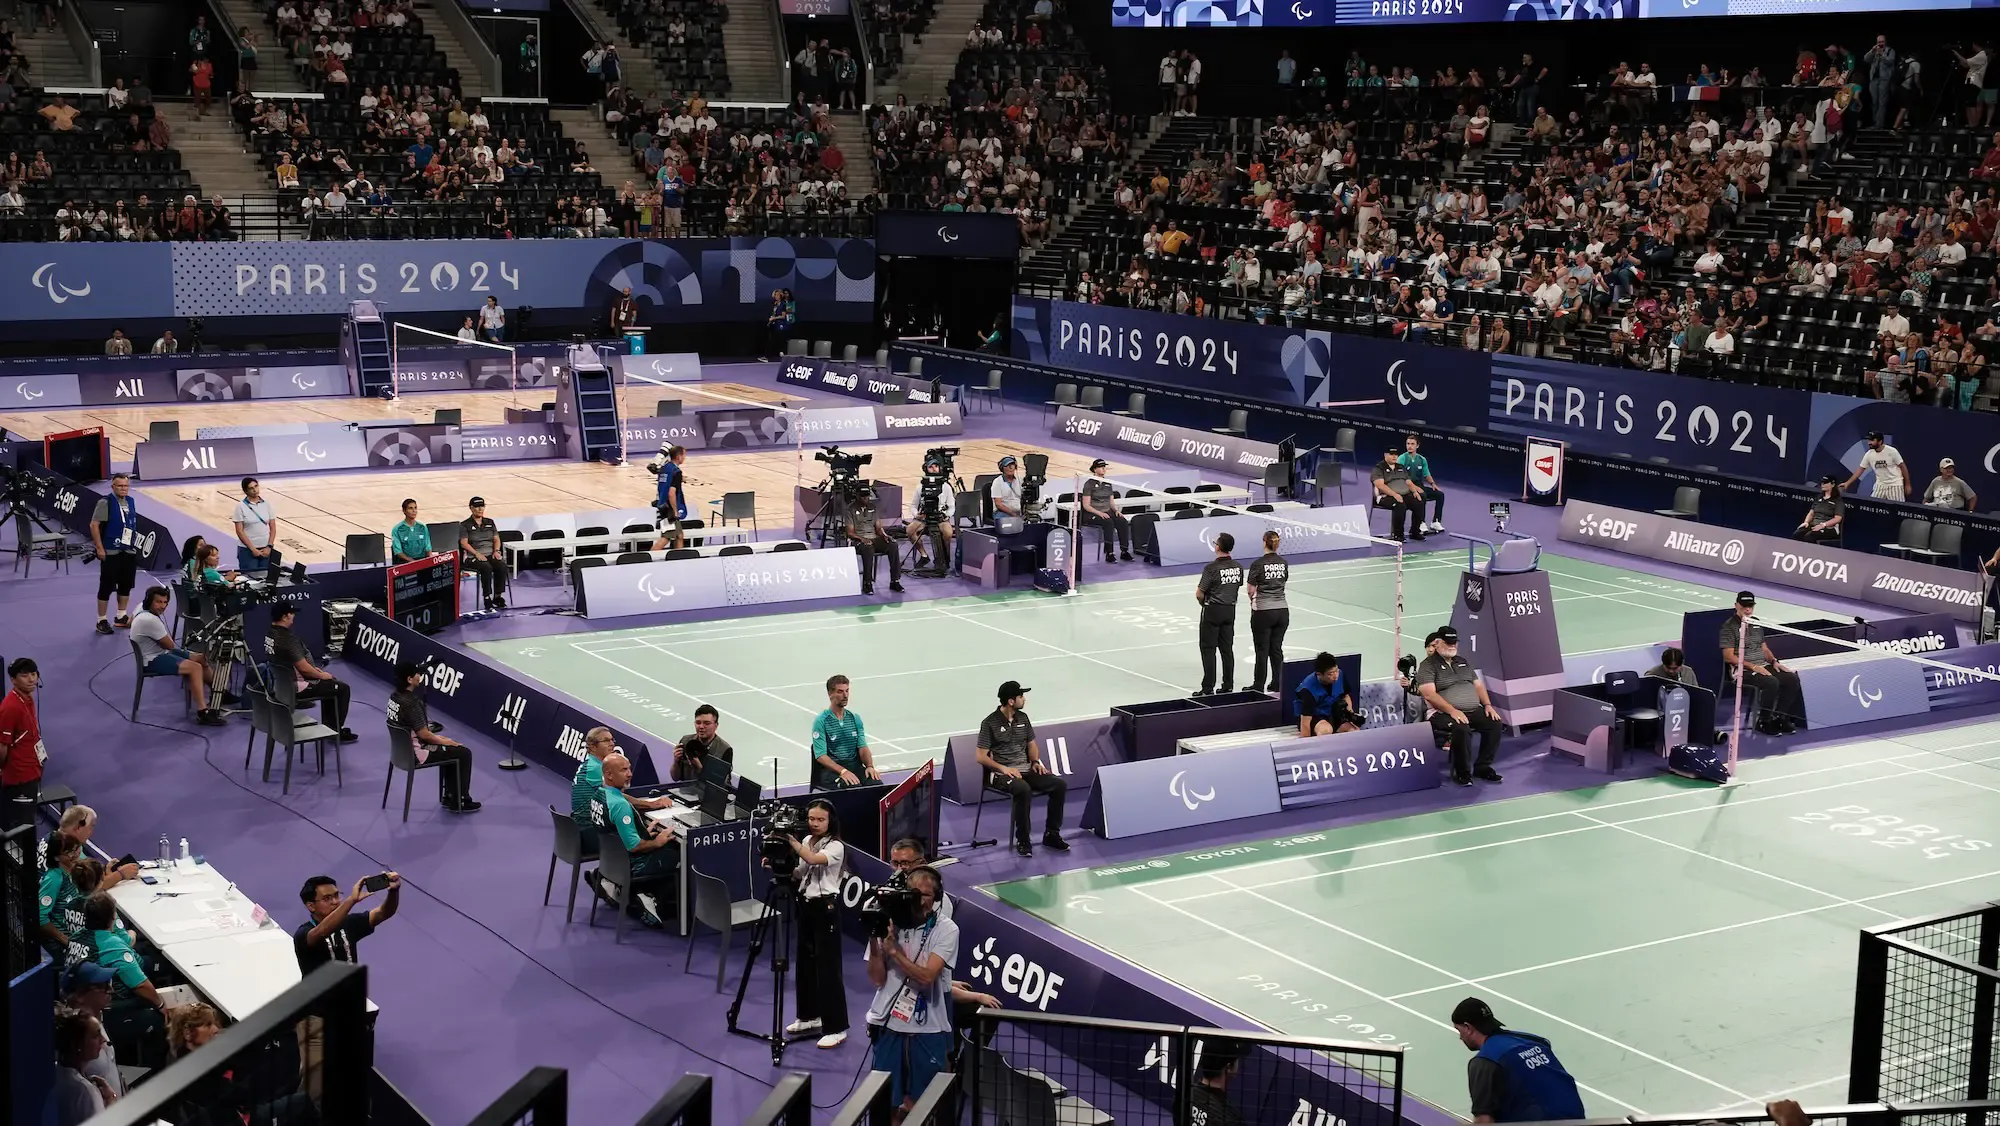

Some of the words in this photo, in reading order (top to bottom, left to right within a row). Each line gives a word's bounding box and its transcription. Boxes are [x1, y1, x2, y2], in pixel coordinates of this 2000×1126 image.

[1372, 0, 1416, 16] PARIS
[1421, 0, 1463, 14] 2024
[236, 263, 377, 296] PARIS
[400, 261, 519, 293] 2024
[1060, 319, 1142, 361] PARIS
[1155, 332, 1237, 375] 2024
[432, 371, 463, 380] 2024
[823, 371, 847, 386] Allianz
[885, 413, 951, 428] Panasonic
[1505, 378, 1634, 434] PARIS
[1655, 400, 1788, 458] 2024
[661, 427, 697, 438] 2024
[1117, 426, 1151, 445] Allianz
[470, 437, 513, 448] PARIS
[518, 435, 557, 446] 2024
[1181, 438, 1225, 460] TOYOTA
[1536, 460, 1553, 469] BWF
[1664, 531, 1721, 557] Allianz
[1054, 548, 1064, 561] 2
[1220, 567, 1241, 577] PARIS
[1264, 563, 1285, 572] PARIS
[1771, 551, 1848, 583] TOYOTA
[737, 569, 792, 587] PARIS
[800, 567, 848, 582] 2024
[1220, 575, 1241, 585] 2024
[1264, 571, 1286, 580] 2024
[1506, 589, 1539, 604] PARIS
[1509, 603, 1541, 617] 2024
[355, 623, 400, 665] TOYOTA
[1470, 634, 1477, 652] 1
[1671, 714, 1682, 732] 2
[1290, 756, 1358, 784] PARIS
[1365, 747, 1425, 772] 2024
[1789, 812, 1951, 860] 2024
[1827, 805, 1993, 852] PARIS
[693, 831, 734, 847] PARIS
[1184, 845, 1260, 862] TOYOTA
[1094, 862, 1149, 877] Allianz
[1236, 974, 1328, 1013] PARIS
[1518, 1046, 1542, 1059] PHOTO
